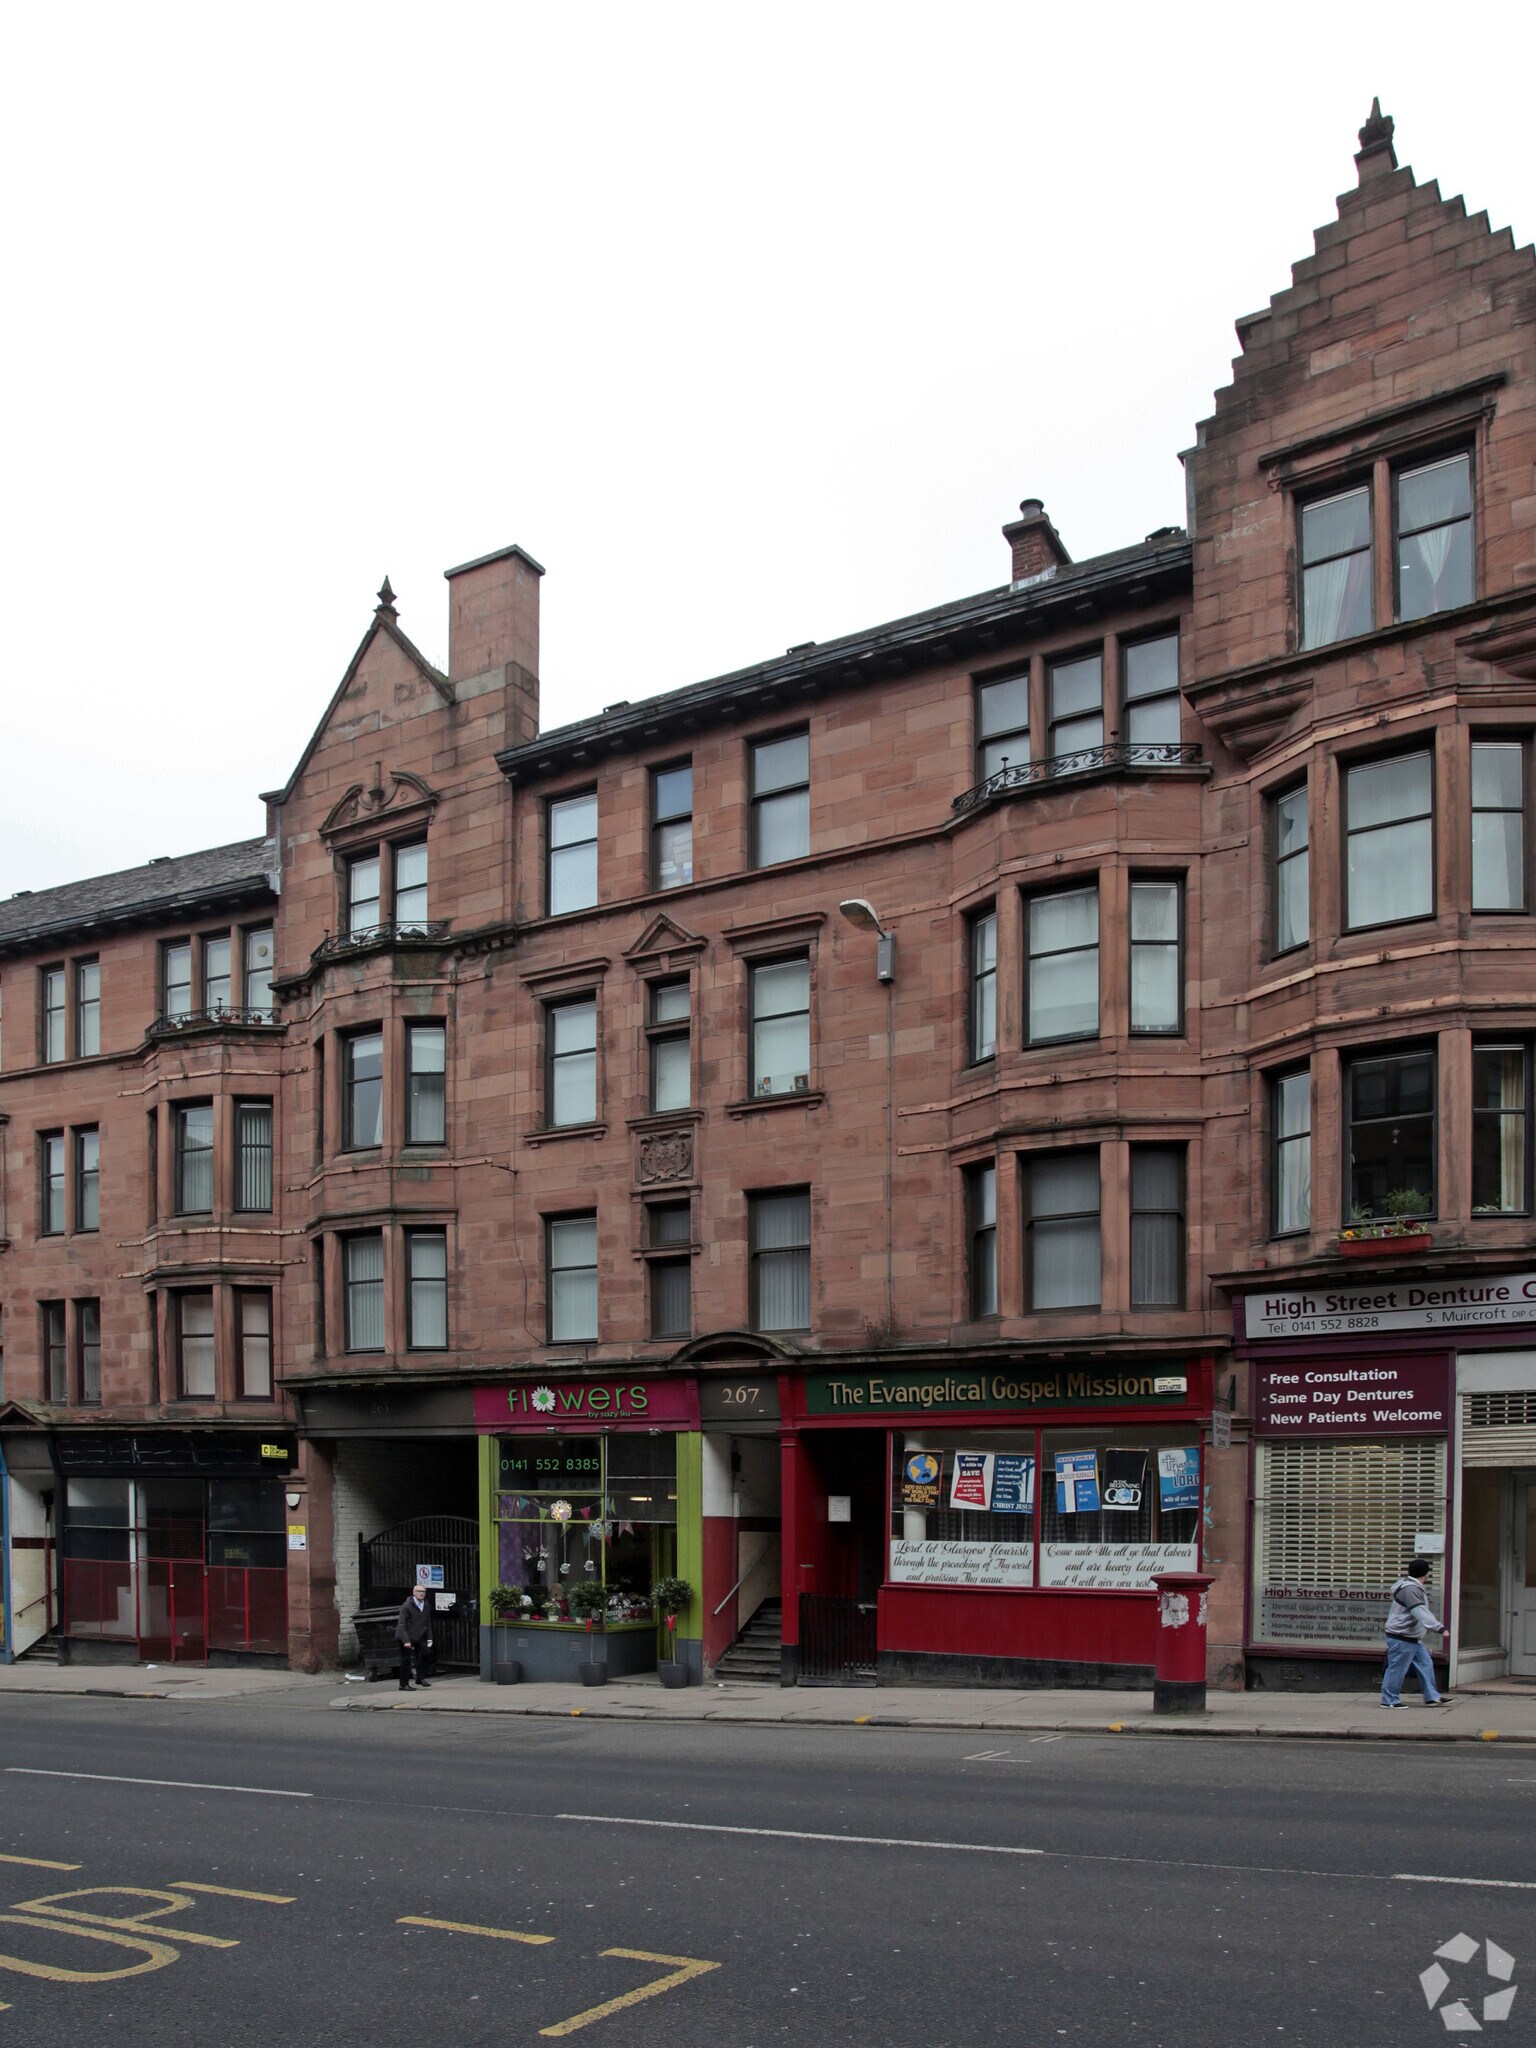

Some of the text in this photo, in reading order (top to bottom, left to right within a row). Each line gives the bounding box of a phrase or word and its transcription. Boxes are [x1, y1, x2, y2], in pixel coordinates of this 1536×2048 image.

[1265, 1281, 1536, 1319] High Street Denture C
[1426, 1312, 1436, 1323] S.
[1442, 1308, 1506, 1322] Muircroft
[1512, 1310, 1526, 1318] DIP
[1268, 1317, 1379, 1333] Tel: 0141 552 8828
[1270, 1369, 1398, 1384] Free Consultation
[722, 1386, 760, 1404] 267
[828, 1372, 1153, 1407] The Evangelical Gospel Mission
[508, 1386, 648, 1412] flowers
[1270, 1390, 1414, 1405] Same Day Dentures
[588, 1411, 599, 1419] by
[1270, 1409, 1442, 1424] New Patients Welcome
[501, 1459, 599, 1470] 0141 552 8385
[1189, 1460, 1196, 1468] in
[926, 1543, 939, 1554] let
[941, 1543, 986, 1558] Glasgow
[990, 1544, 1029, 1558] flourish
[1046, 1544, 1192, 1561] Come unto Me all ye that labour
[893, 1556, 1032, 1573] through the preaching of Thy word
[1065, 1561, 1165, 1575] and are heavy laden
[906, 1572, 924, 1581] and
[925, 1573, 959, 1583] praising
[960, 1572, 978, 1584] Thy
[1051, 1576, 1068, 1586] and
[1070, 1575, 1078, 1586] I
[1079, 1576, 1096, 1587] will
[1097, 1579, 1113, 1588] give
[1264, 1587, 1391, 1599] High Street Denture
[1299, 1605, 1324, 1613] repairs
[1272, 1613, 1317, 1622] Emergencies
[1332, 1625, 1357, 1633] elderly
[1304, 1633, 1336, 1641] patients
[1338, 1634, 1372, 1642] welcome
